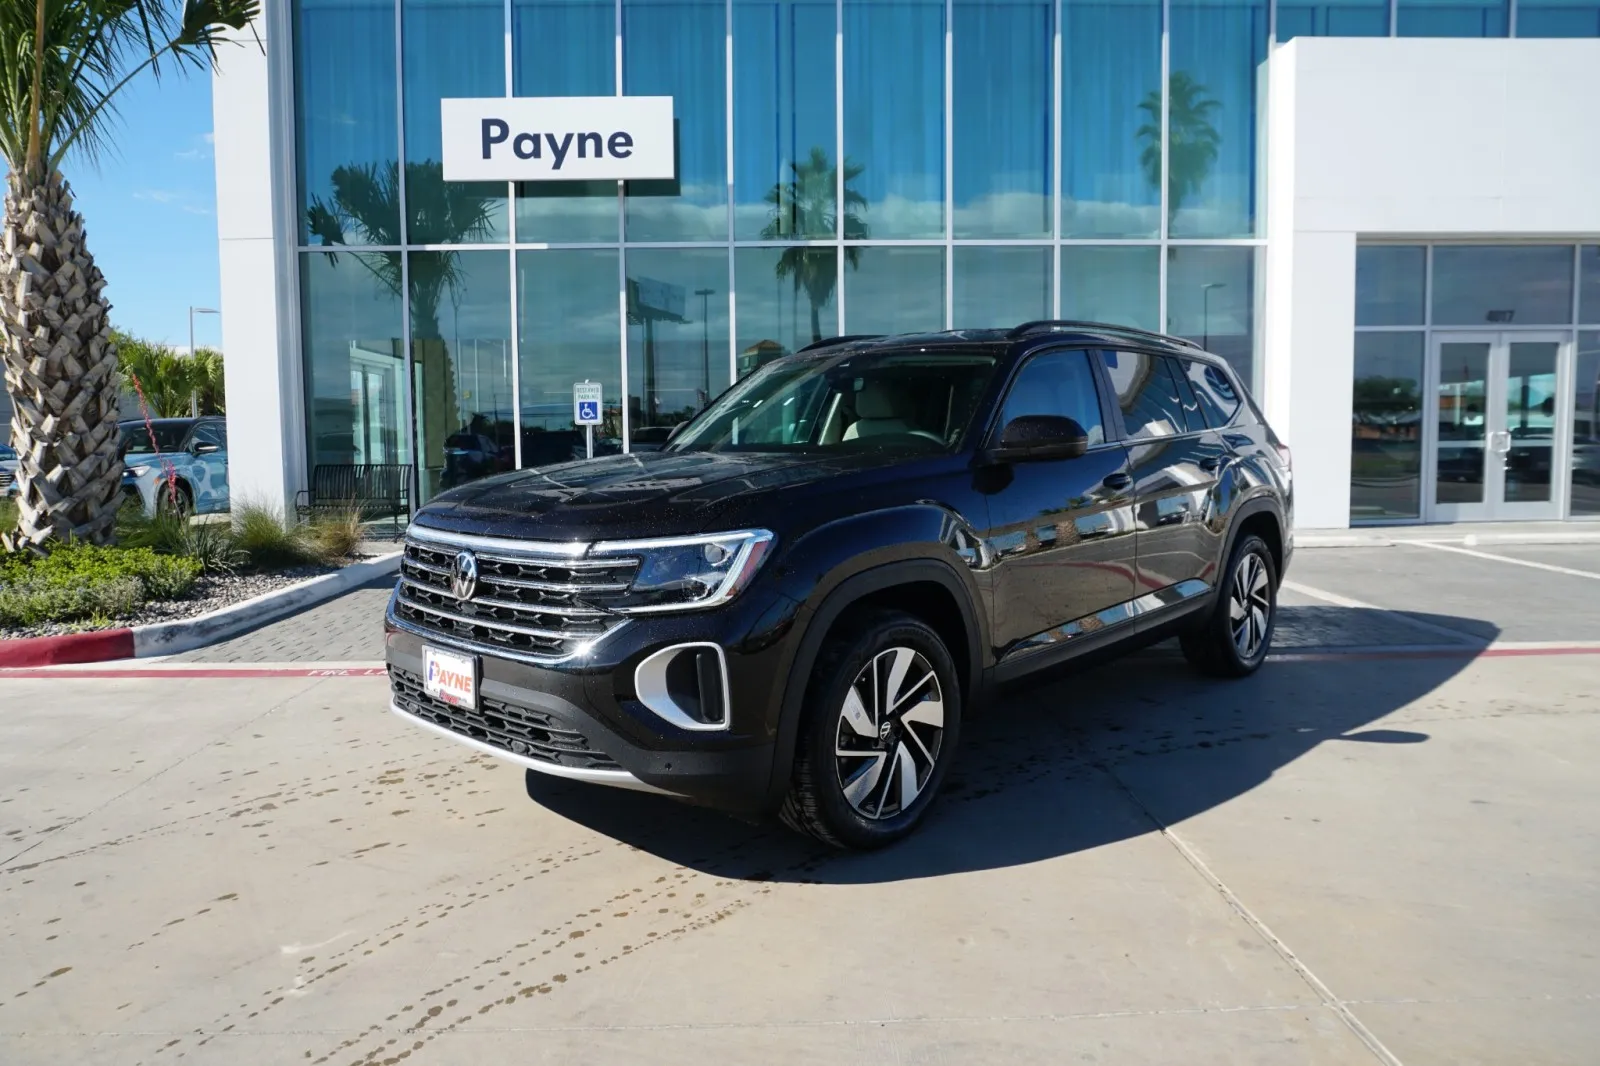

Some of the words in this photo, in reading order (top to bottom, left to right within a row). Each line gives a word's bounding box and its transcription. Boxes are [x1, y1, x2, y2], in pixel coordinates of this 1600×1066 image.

[482, 118, 633, 170] Payne
[307, 668, 356, 676] FIRE
[363, 668, 388, 676] LA
[428, 661, 472, 693] PAYNE
